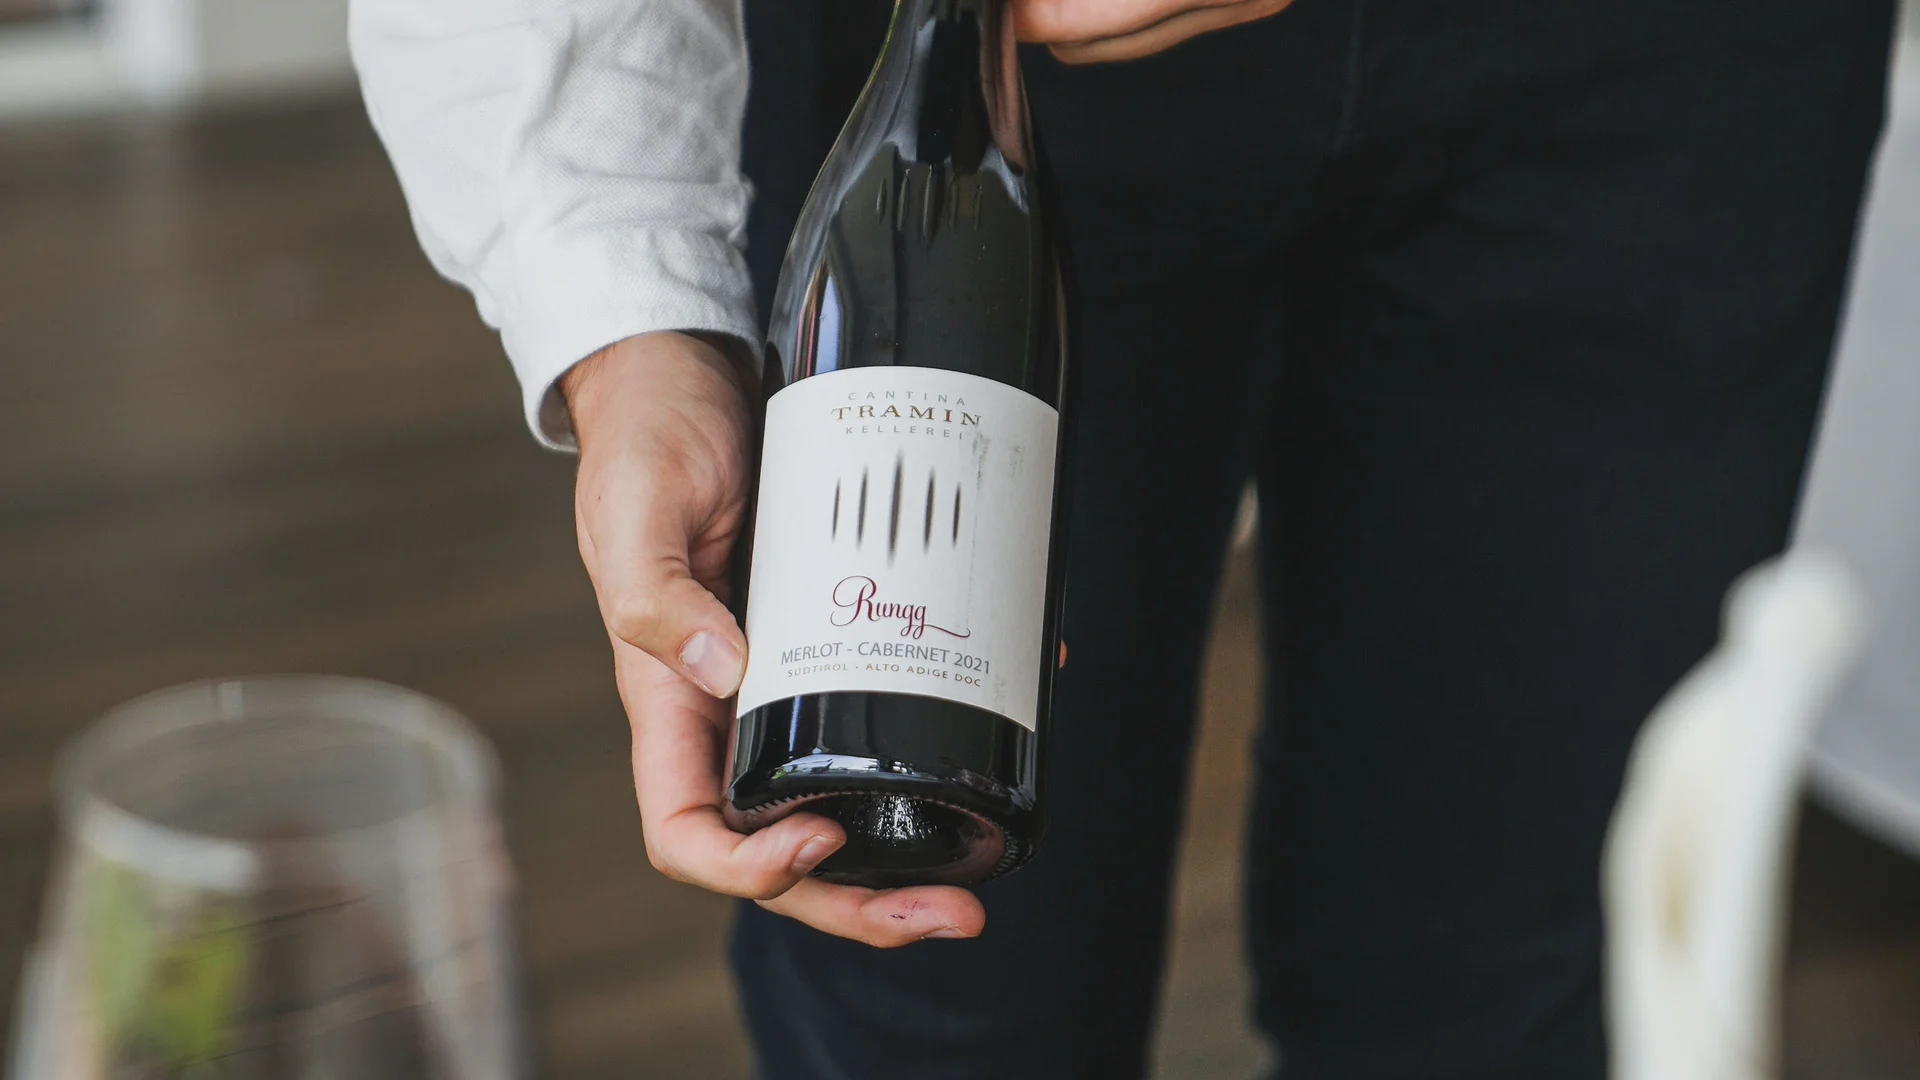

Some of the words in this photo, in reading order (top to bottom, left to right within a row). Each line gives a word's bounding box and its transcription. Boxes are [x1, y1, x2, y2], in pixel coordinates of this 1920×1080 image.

[848, 391, 966, 406] CANTINA
[830, 404, 982, 426] TRAMIN
[845, 425, 963, 440] KELLEREI
[830, 575, 971, 639] Rungg
[781, 642, 843, 665] MERLOT
[858, 642, 951, 664] CABERNET
[954, 652, 991, 674] 2021
[865, 663, 900, 672] ALTO
[906, 666, 949, 679] ADIGE
[954, 673, 982, 687] DOC
